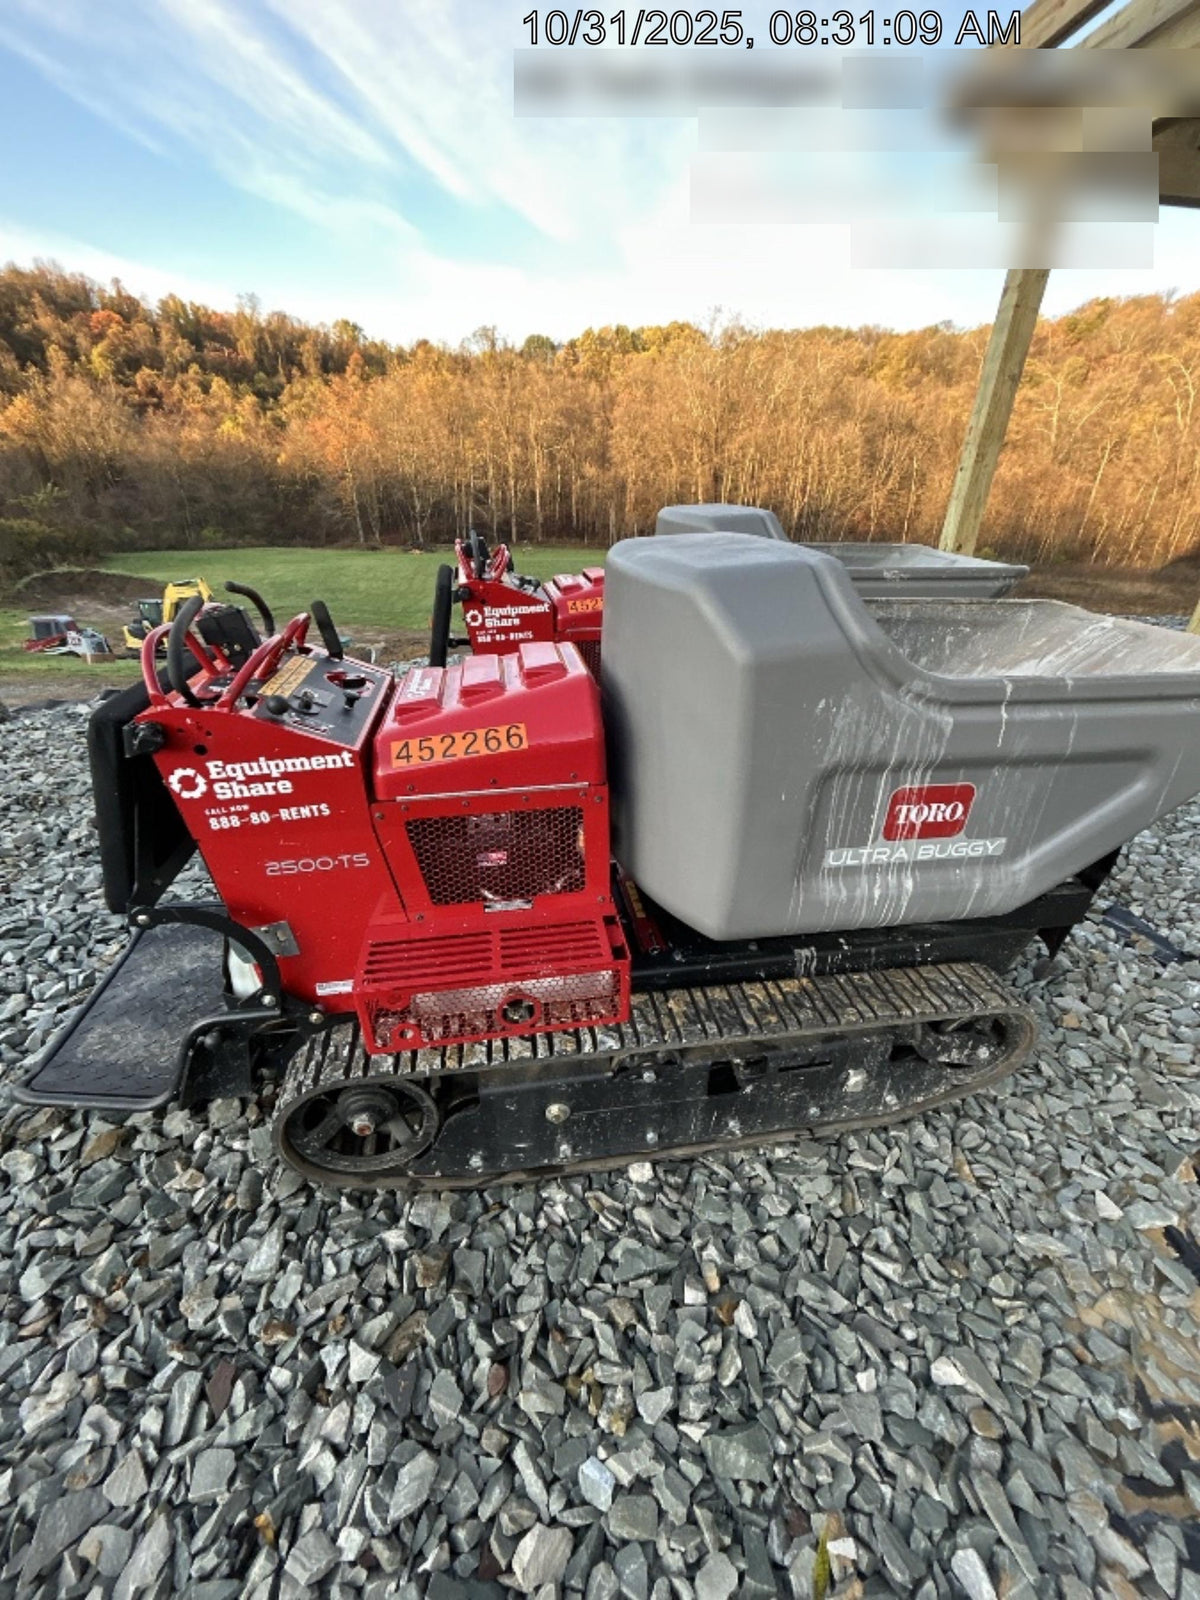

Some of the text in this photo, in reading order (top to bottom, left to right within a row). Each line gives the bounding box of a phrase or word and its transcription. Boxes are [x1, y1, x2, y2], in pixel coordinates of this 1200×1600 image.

[484, 603, 550, 617] Equipment
[394, 724, 524, 764] 452266
[206, 750, 355, 781] Equipment
[213, 779, 293, 800] Share
[204, 803, 250, 815] CALL NOW
[209, 803, 331, 830] 888-80-RENTS
[895, 801, 964, 825] TORO
[829, 840, 1000, 865] ULTRA BUGGY
